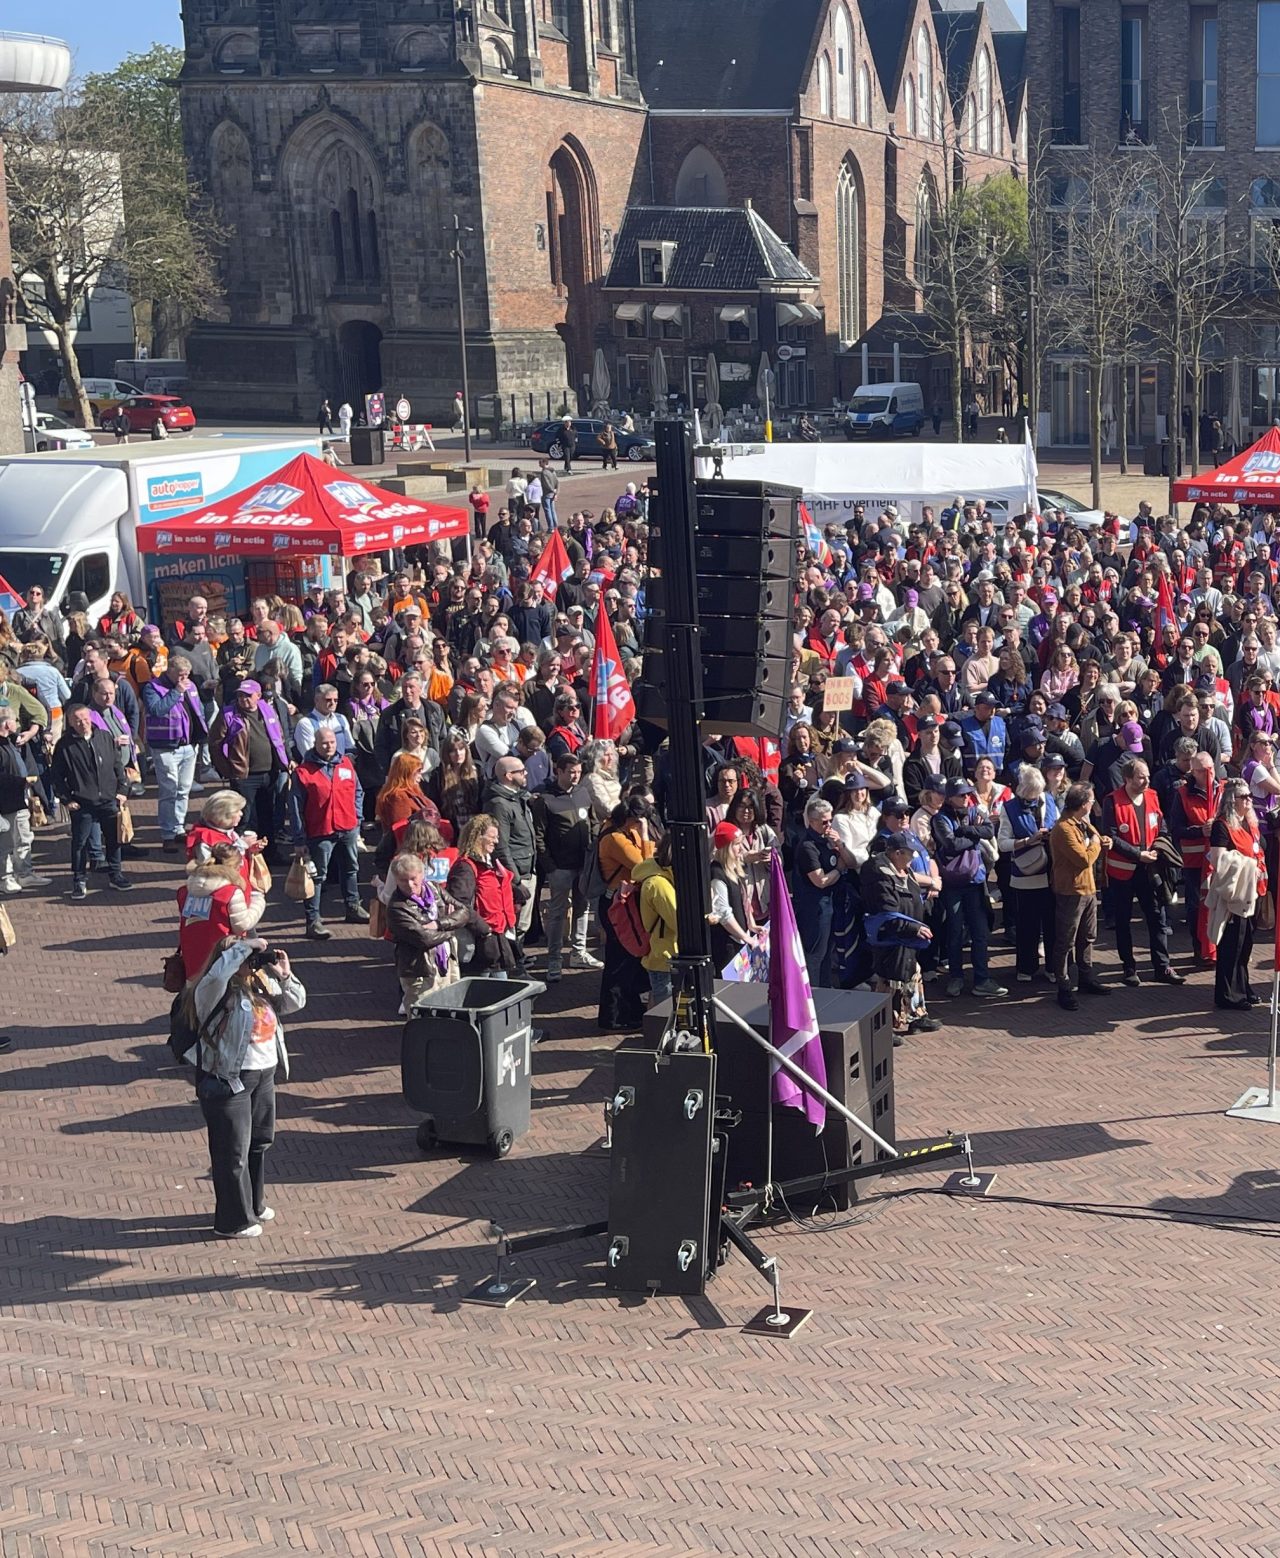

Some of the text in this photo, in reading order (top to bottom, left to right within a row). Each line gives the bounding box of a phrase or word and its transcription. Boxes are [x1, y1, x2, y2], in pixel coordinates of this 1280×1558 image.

[1214, 474, 1239, 483] in
[150, 478, 199, 496] autohopper
[332, 484, 371, 505] FNV
[248, 489, 300, 509] FNV
[194, 512, 314, 527] in actie
[174, 534, 183, 543] in
[185, 535, 206, 543] actie
[232, 535, 241, 543] in
[243, 535, 265, 544] actie
[291, 537, 300, 545] in
[302, 538, 324, 546] actie
[155, 560, 207, 578] maken
[185, 898, 211, 913] FNV
